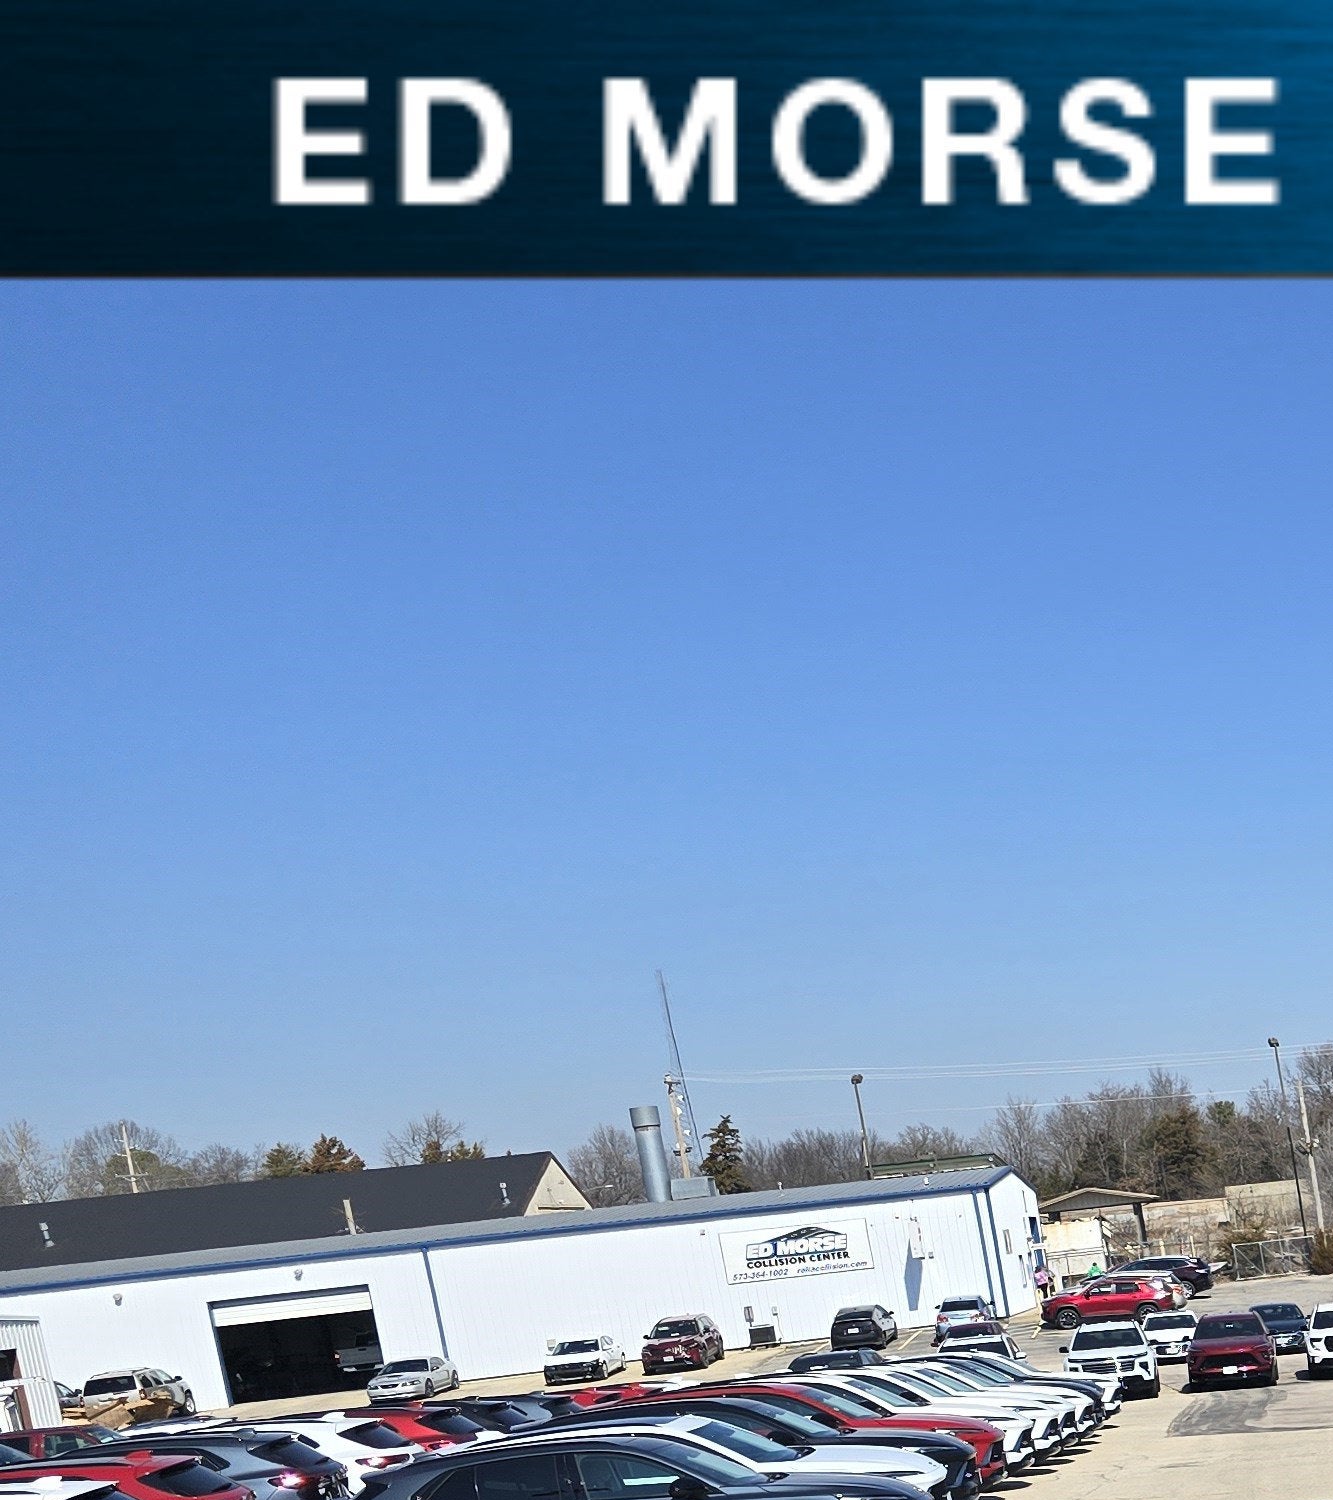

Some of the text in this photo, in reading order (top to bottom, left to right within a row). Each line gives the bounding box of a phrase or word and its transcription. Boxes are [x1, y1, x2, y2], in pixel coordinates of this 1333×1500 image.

[746, 1234, 848, 1261] ED MORSE
[746, 1251, 851, 1269] COLLISION CENTER
[732, 1268, 789, 1281] 573-364-1002
